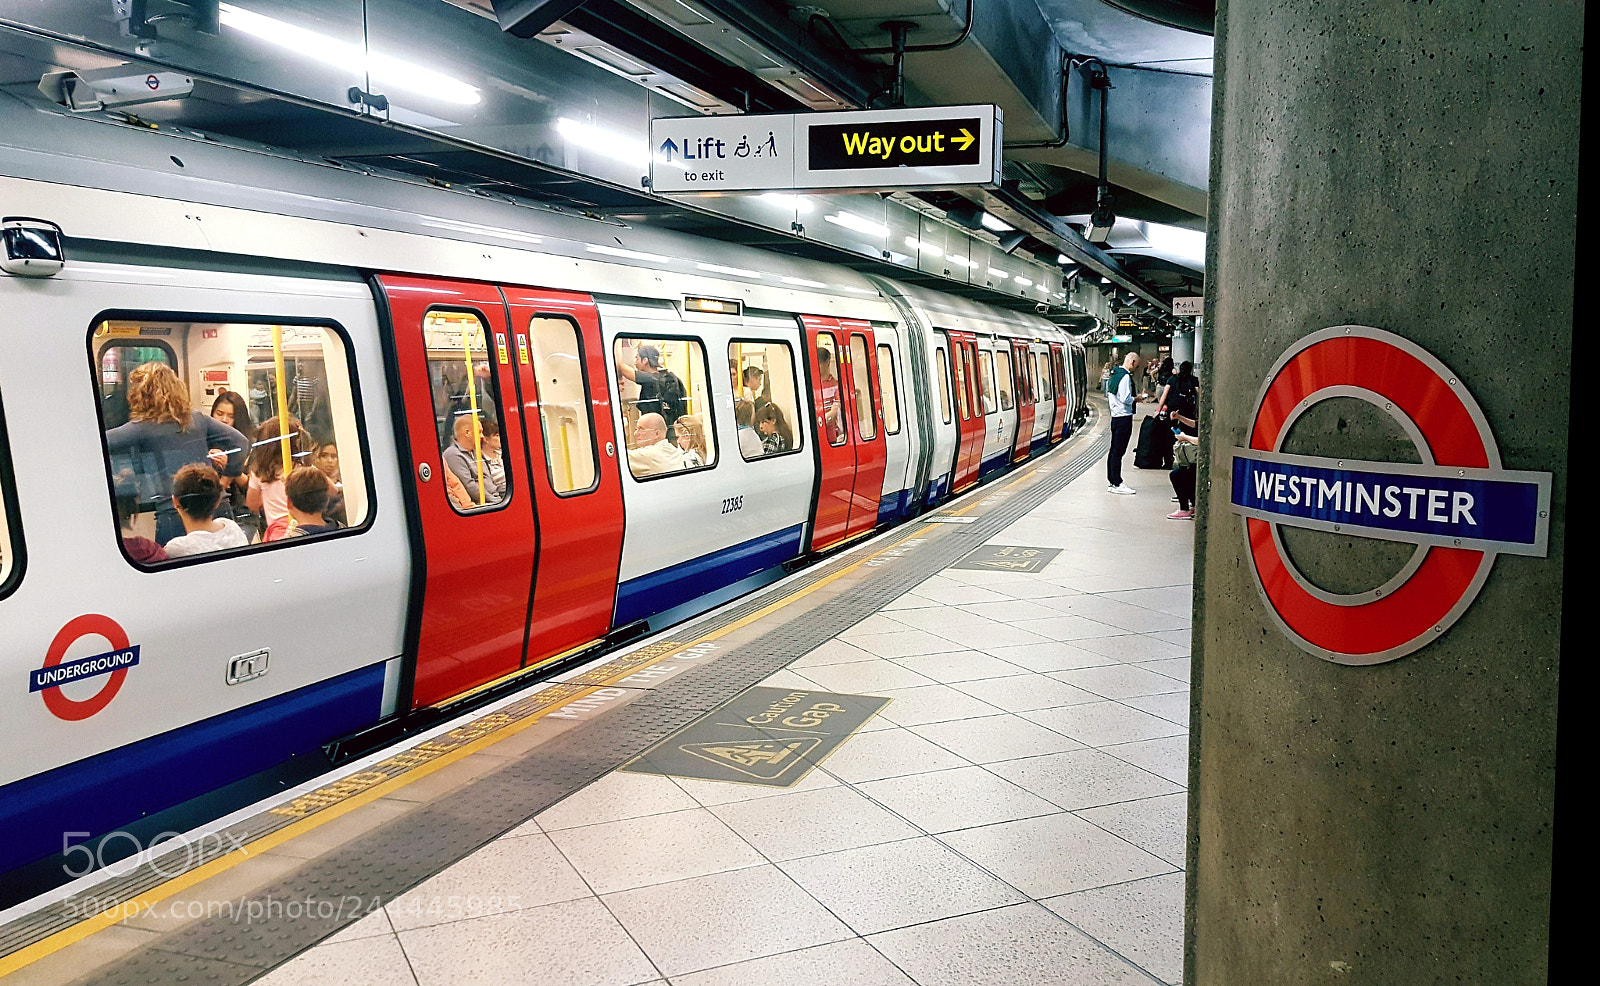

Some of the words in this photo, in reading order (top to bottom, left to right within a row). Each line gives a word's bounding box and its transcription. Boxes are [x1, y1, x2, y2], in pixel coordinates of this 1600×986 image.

[683, 136, 726, 160] Lift
[842, 131, 896, 160] Way
[899, 131, 945, 154] out
[684, 170, 698, 181] to
[701, 169, 725, 181] exit
[1254, 470, 1478, 526] WESTMINSTER
[37, 651, 134, 685] UNDERGROUND
[547, 687, 628, 720] MIND
[619, 664, 678, 683] THE
[673, 642, 721, 660] GAP
[746, 692, 809, 724] Caution
[782, 702, 846, 728] Gap
